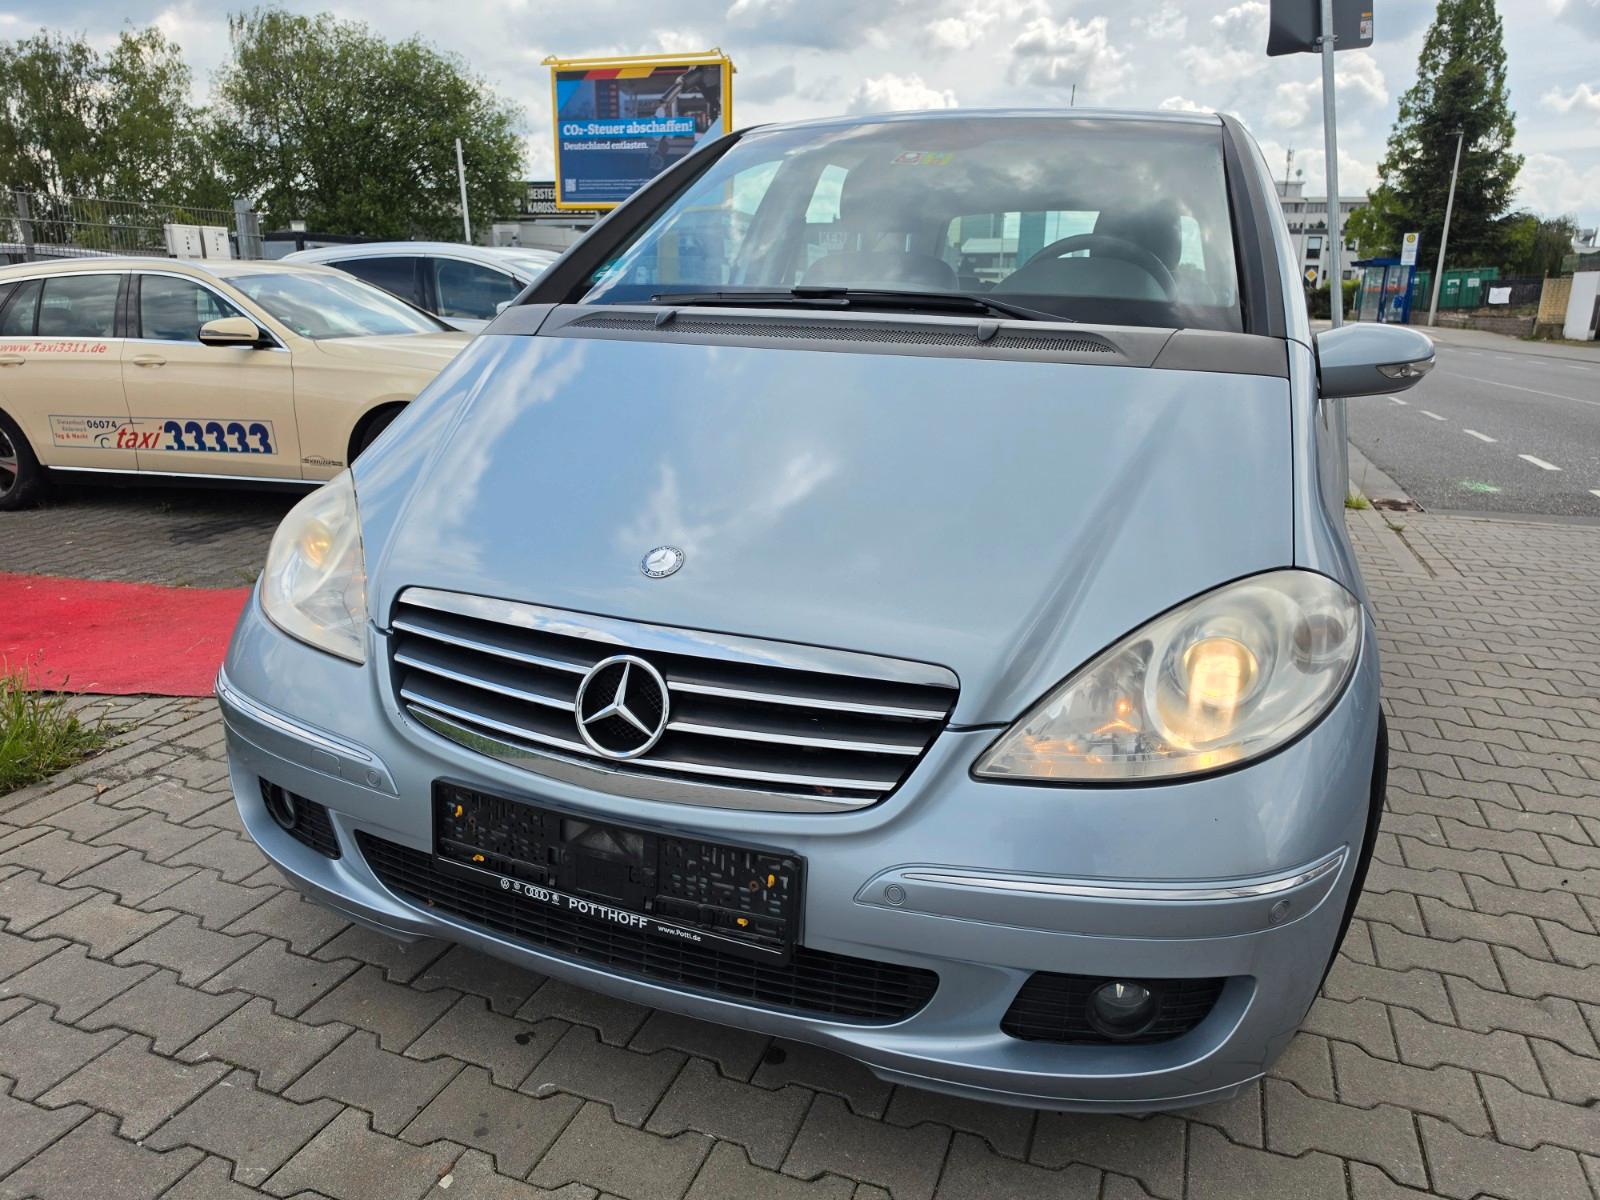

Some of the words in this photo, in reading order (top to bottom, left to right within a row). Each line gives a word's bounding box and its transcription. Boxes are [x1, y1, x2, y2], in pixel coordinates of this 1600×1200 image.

[626, 120, 693, 133] abschaffen!
[563, 141, 610, 151] Deutschland
[611, 140, 649, 150] entlasten.
[0, 342, 107, 353] www.Taxi3311.de
[86, 419, 117, 429] 06074
[117, 425, 162, 449] taxi
[164, 421, 272, 454] 33333
[568, 897, 648, 929] POTTHOFF
